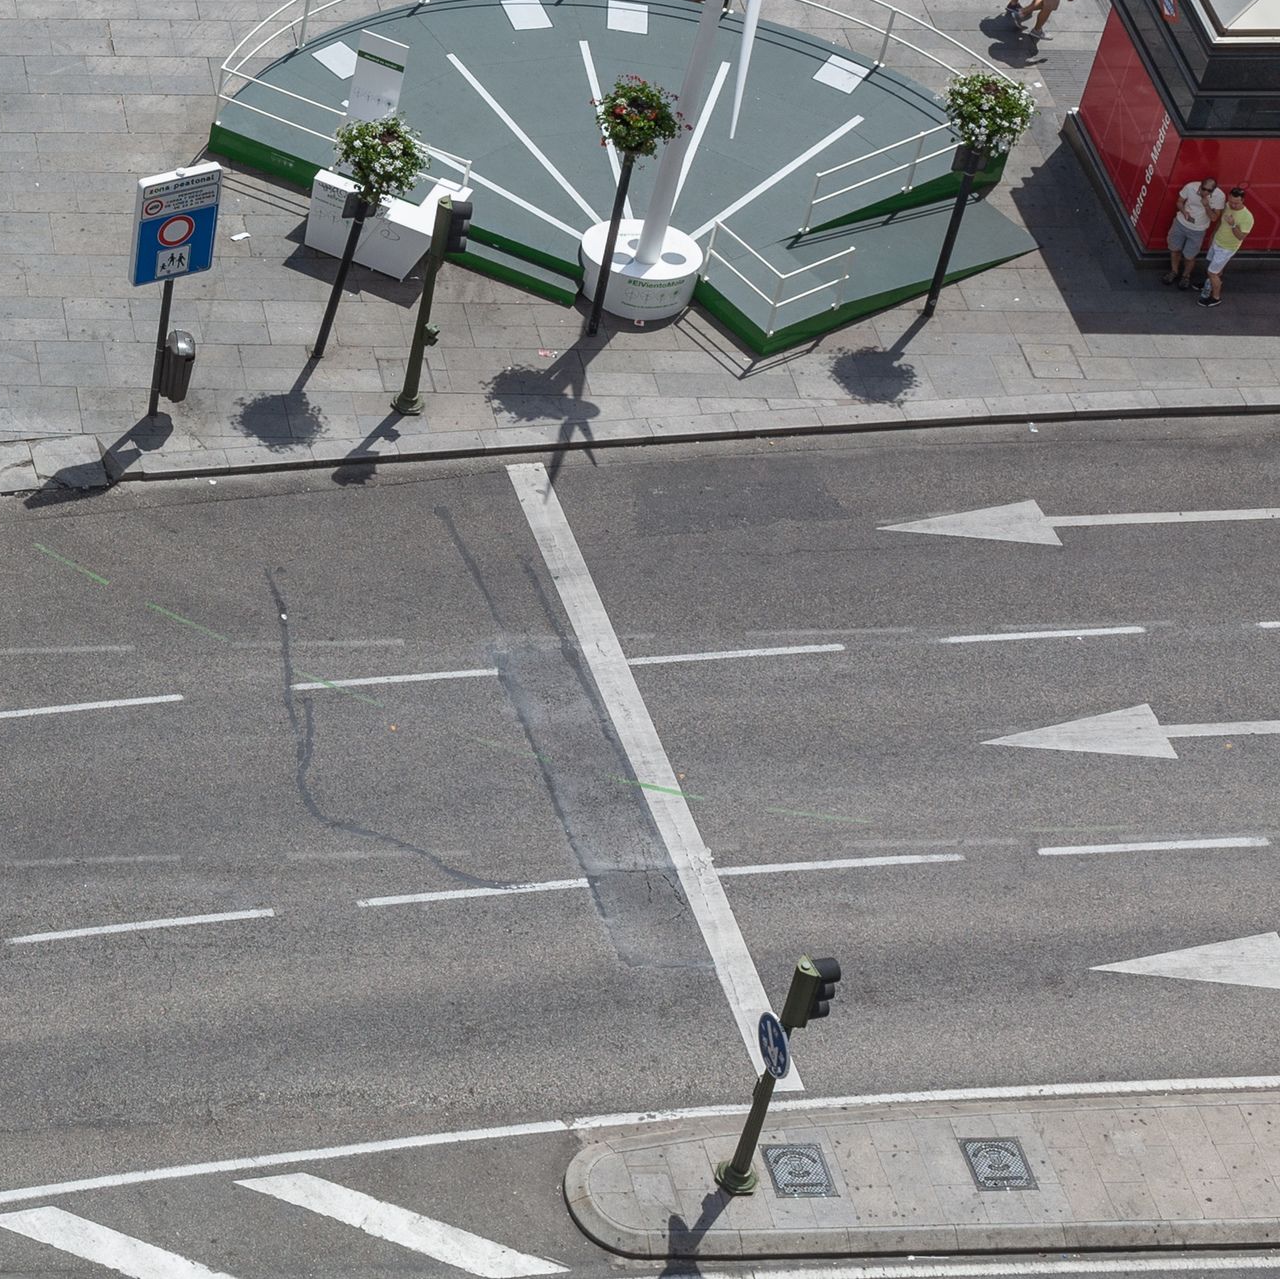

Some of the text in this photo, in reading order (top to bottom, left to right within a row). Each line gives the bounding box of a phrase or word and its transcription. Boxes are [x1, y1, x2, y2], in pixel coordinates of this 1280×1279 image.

[148, 174, 215, 195] zona peatonal
[1130, 111, 1172, 227] Metro de Madrid
